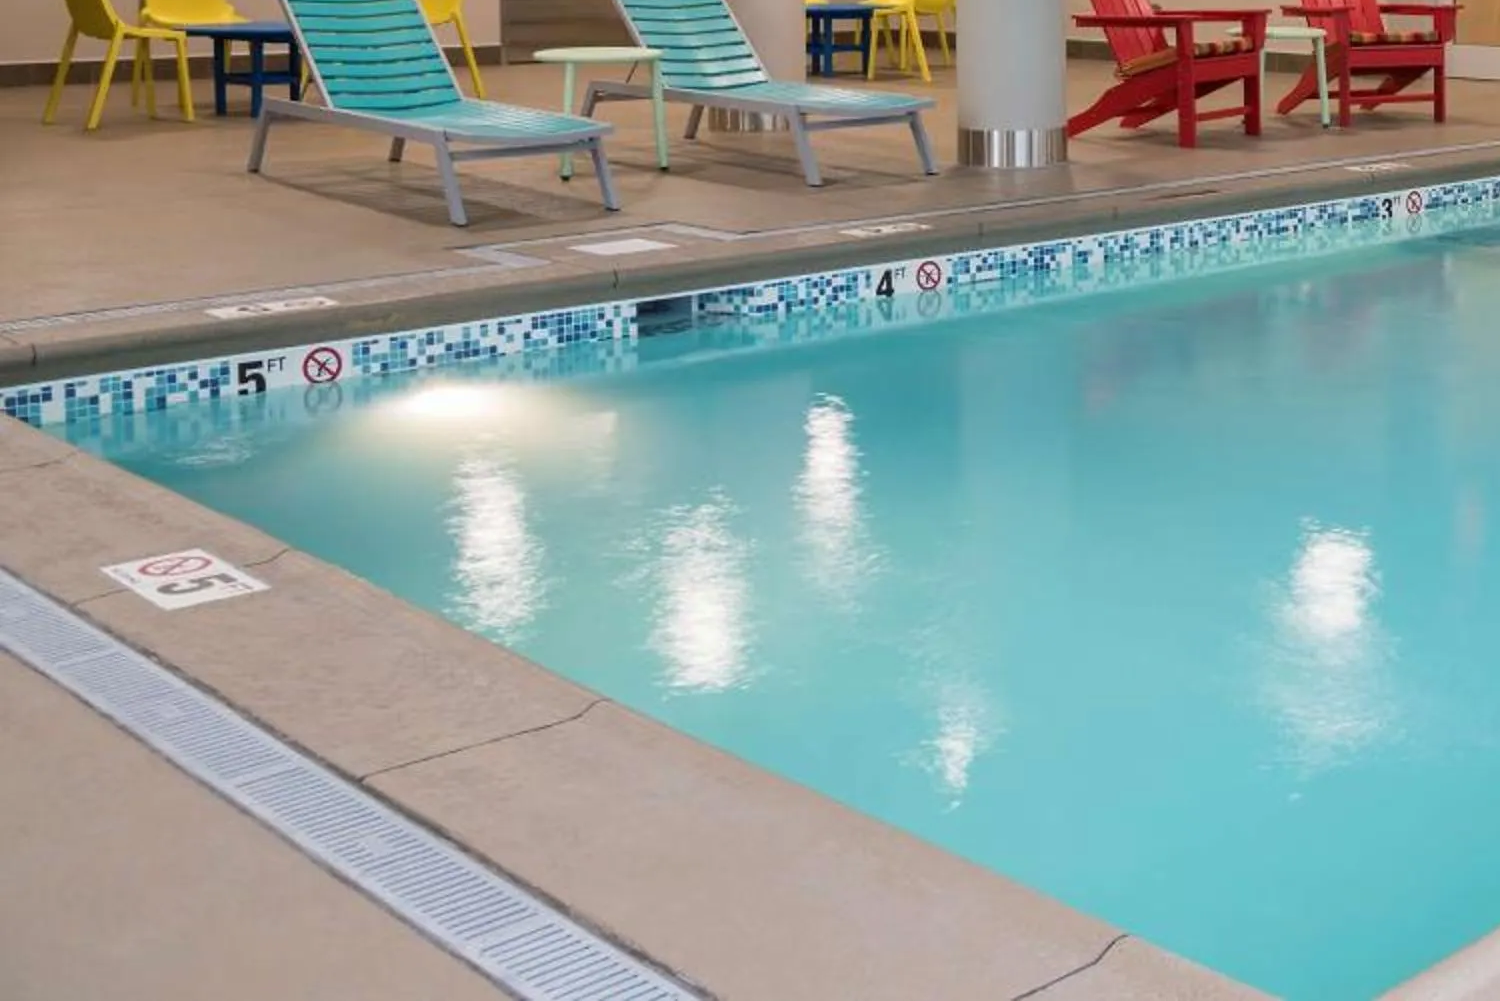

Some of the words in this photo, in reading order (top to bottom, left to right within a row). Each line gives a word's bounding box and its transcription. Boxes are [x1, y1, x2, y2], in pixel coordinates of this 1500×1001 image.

[1381, 198, 1393, 219] 3
[876, 268, 895, 298] 4
[237, 360, 267, 396] 5
[267, 356, 287, 373] FT
[156, 572, 238, 595] 5
